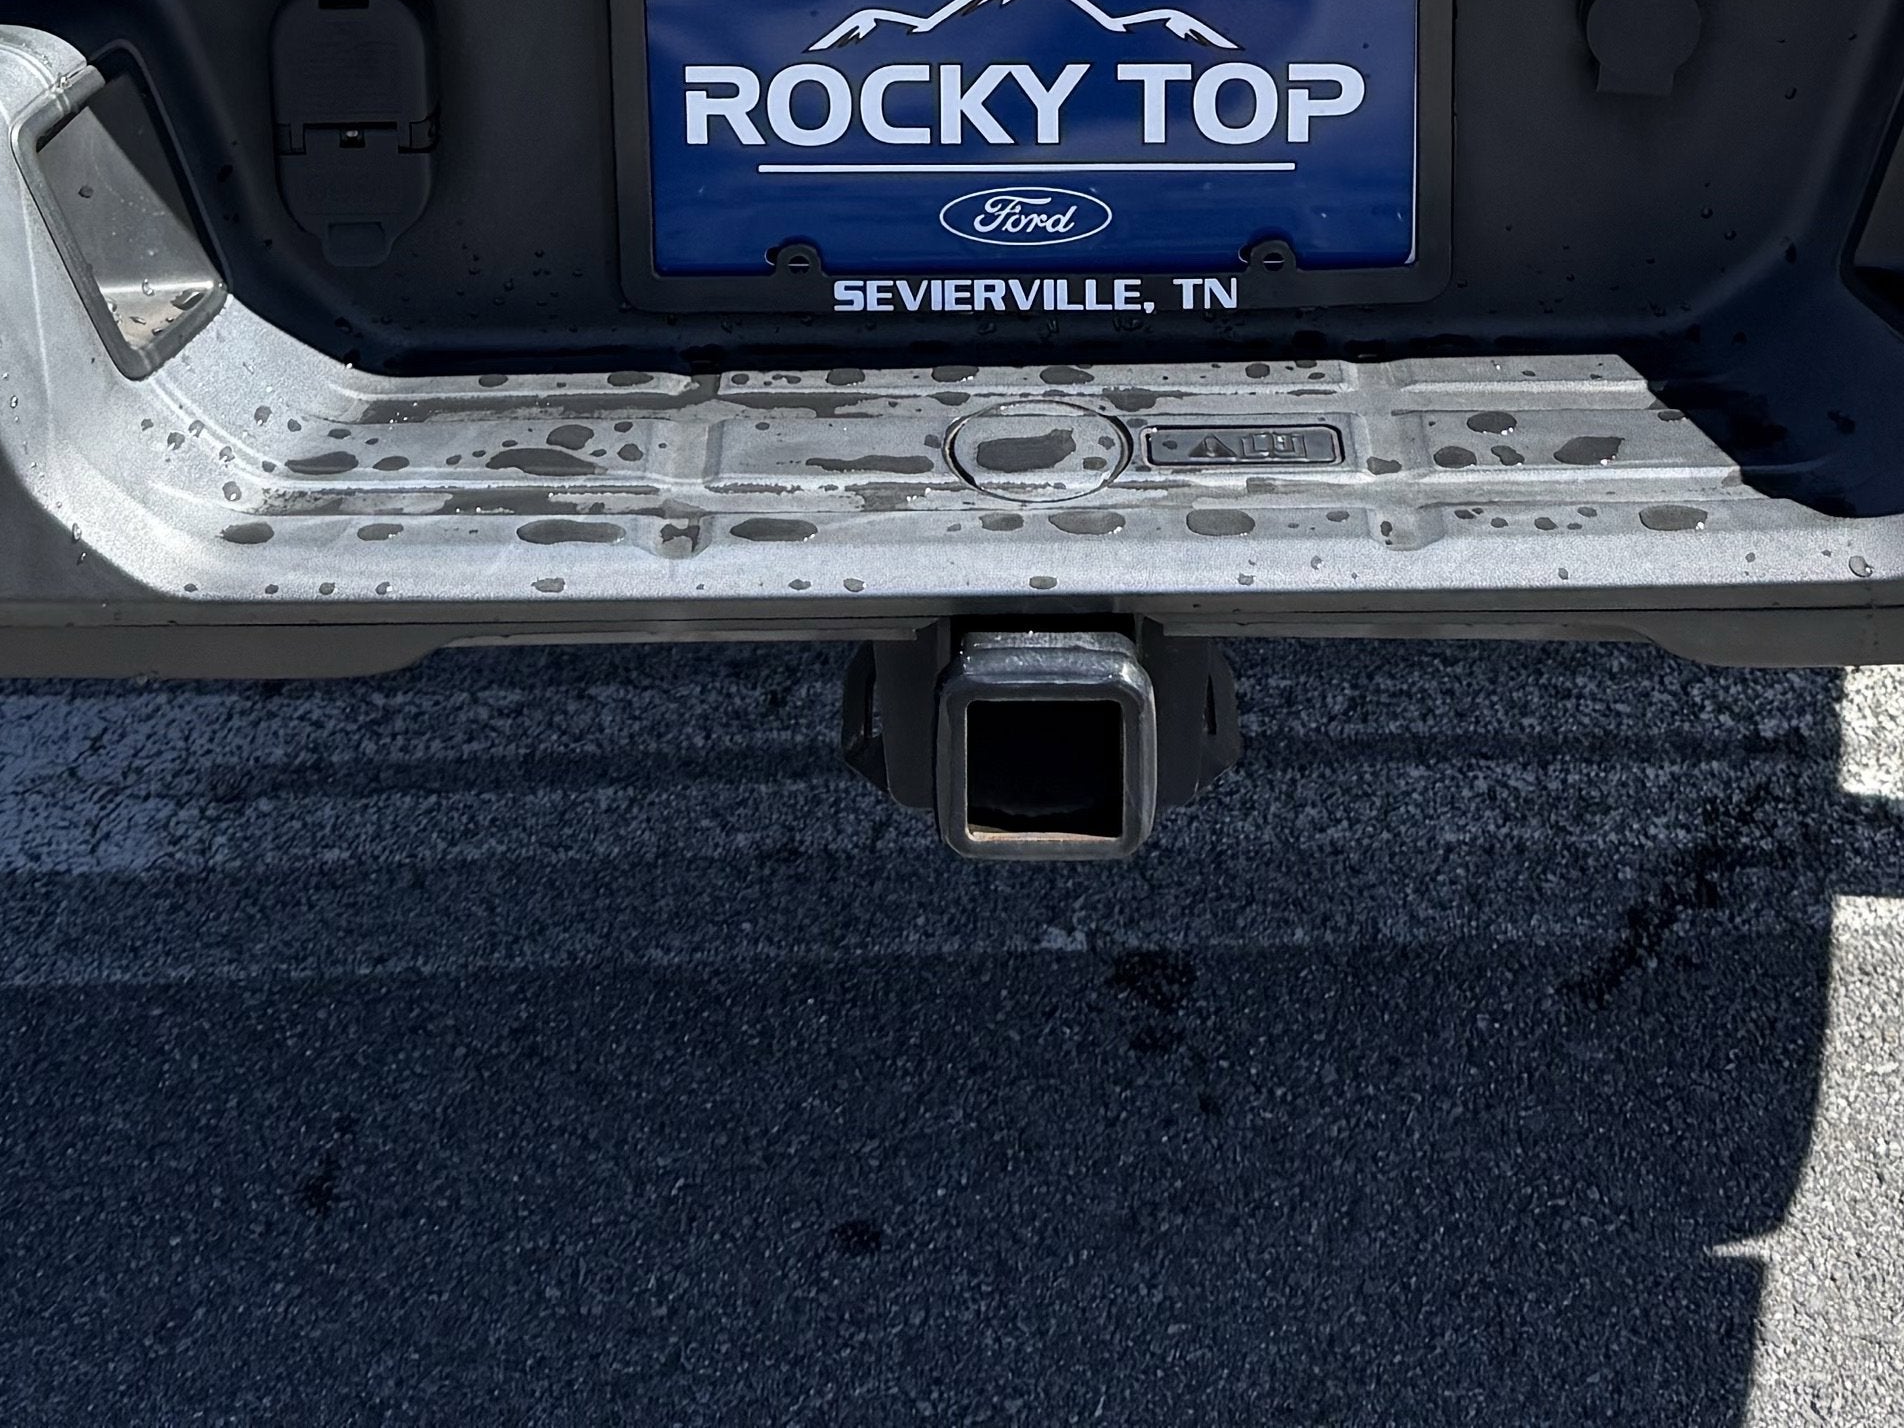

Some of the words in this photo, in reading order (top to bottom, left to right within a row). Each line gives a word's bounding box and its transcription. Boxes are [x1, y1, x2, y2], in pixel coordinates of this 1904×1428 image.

[683, 63, 1092, 145] ROCKY
[1116, 63, 1366, 144] TOP
[973, 197, 1076, 232] Ford
[832, 278, 1156, 316] SEVIERVILLE,
[1173, 277, 1240, 310] TN
